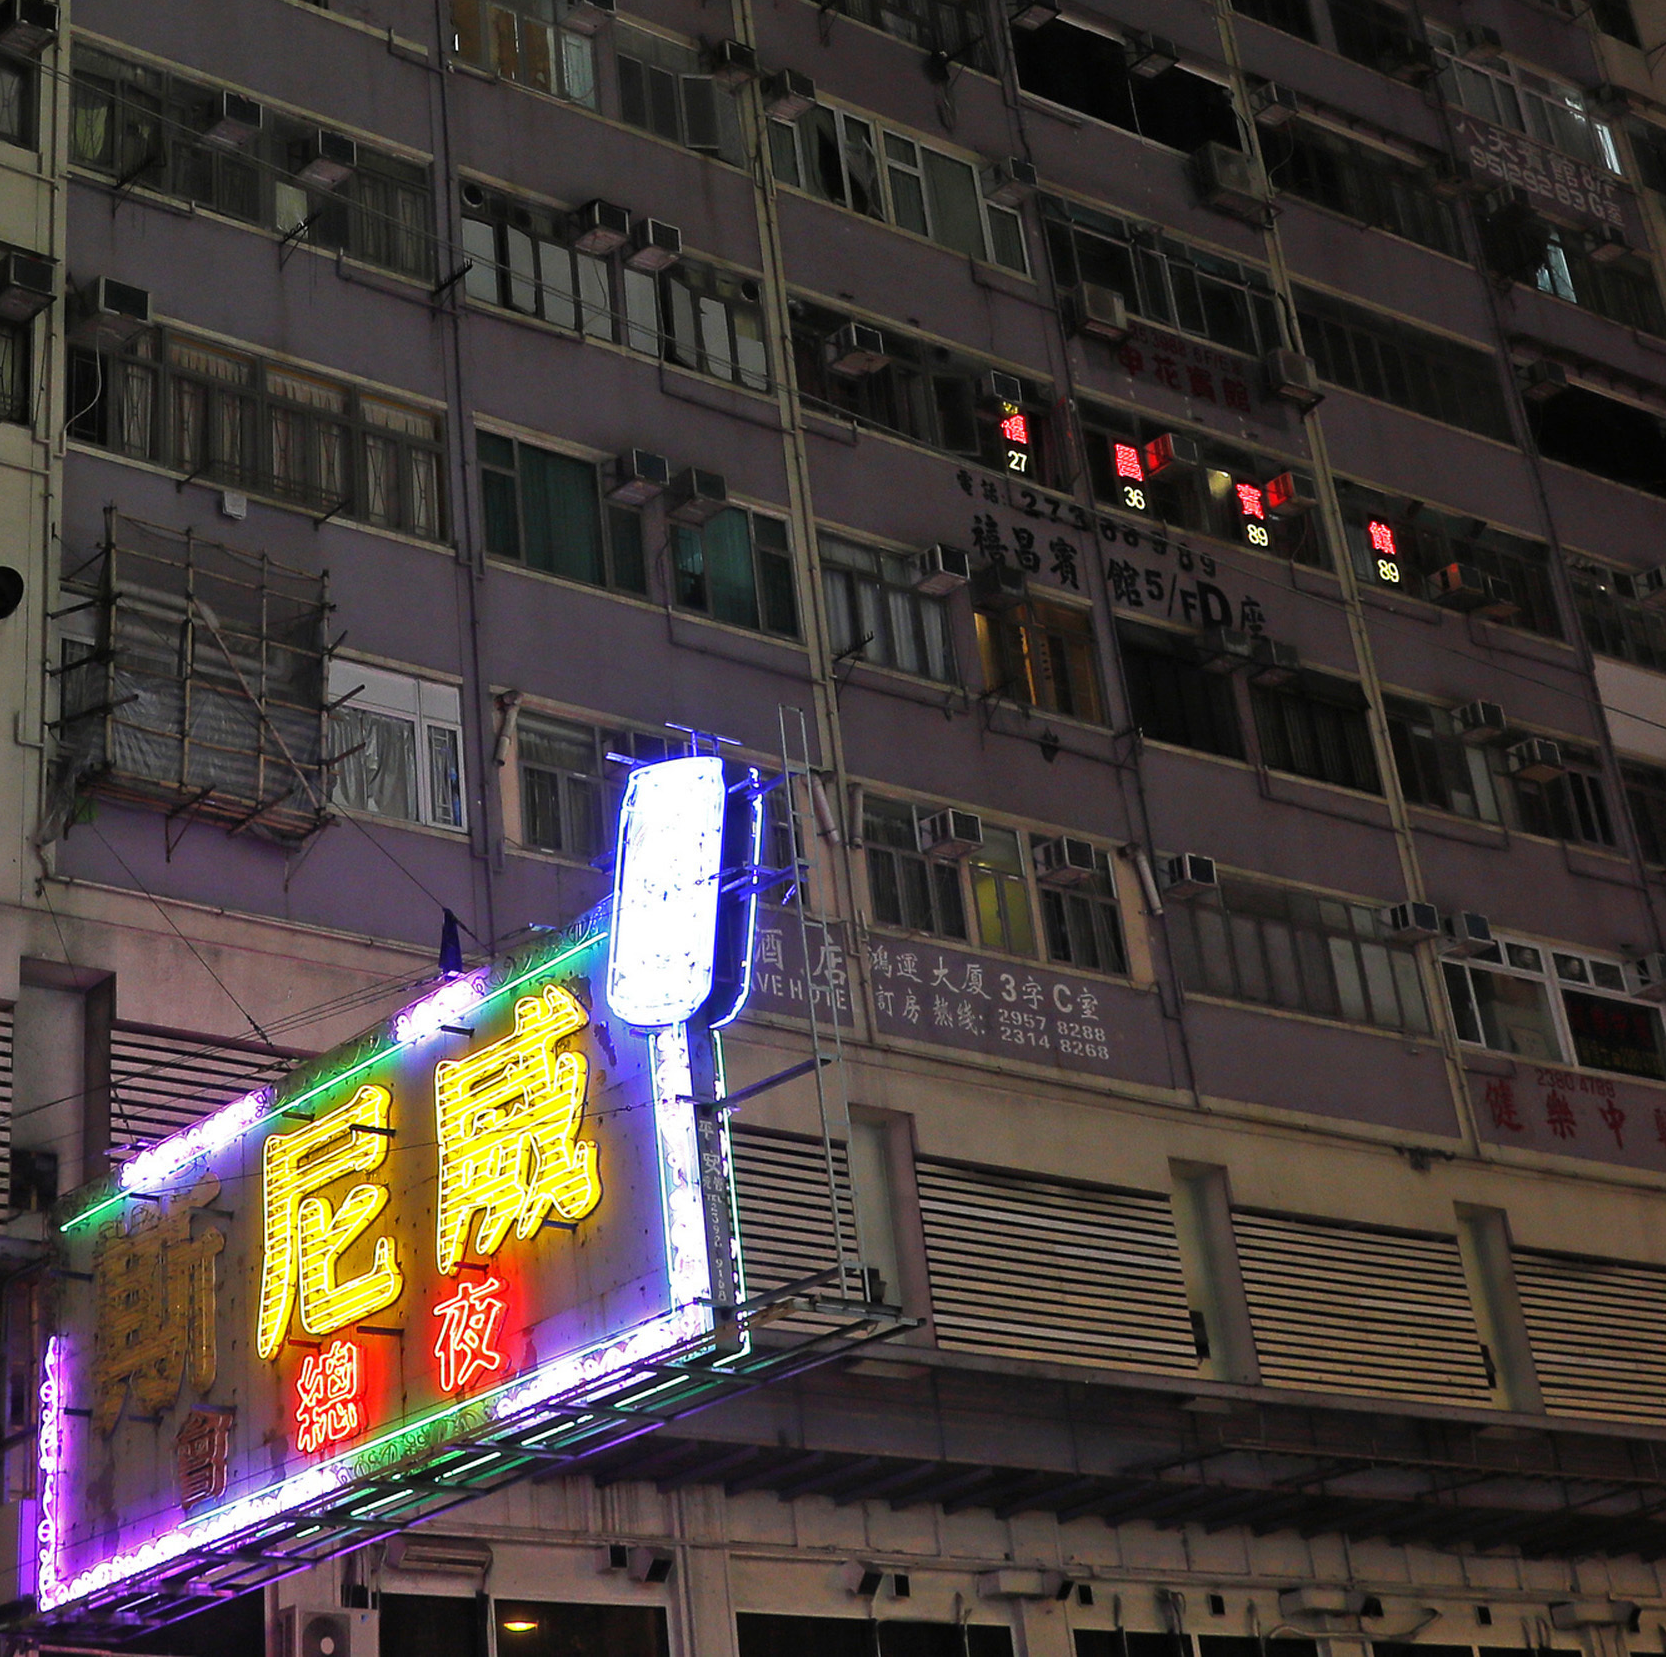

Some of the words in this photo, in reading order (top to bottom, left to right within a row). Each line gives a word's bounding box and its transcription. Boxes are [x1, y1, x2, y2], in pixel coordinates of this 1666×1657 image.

[1007, 450, 1028, 473] 27
[1123, 486, 1146, 510] 36
[1247, 523, 1269, 547] 89
[1377, 559, 1400, 583] 89
